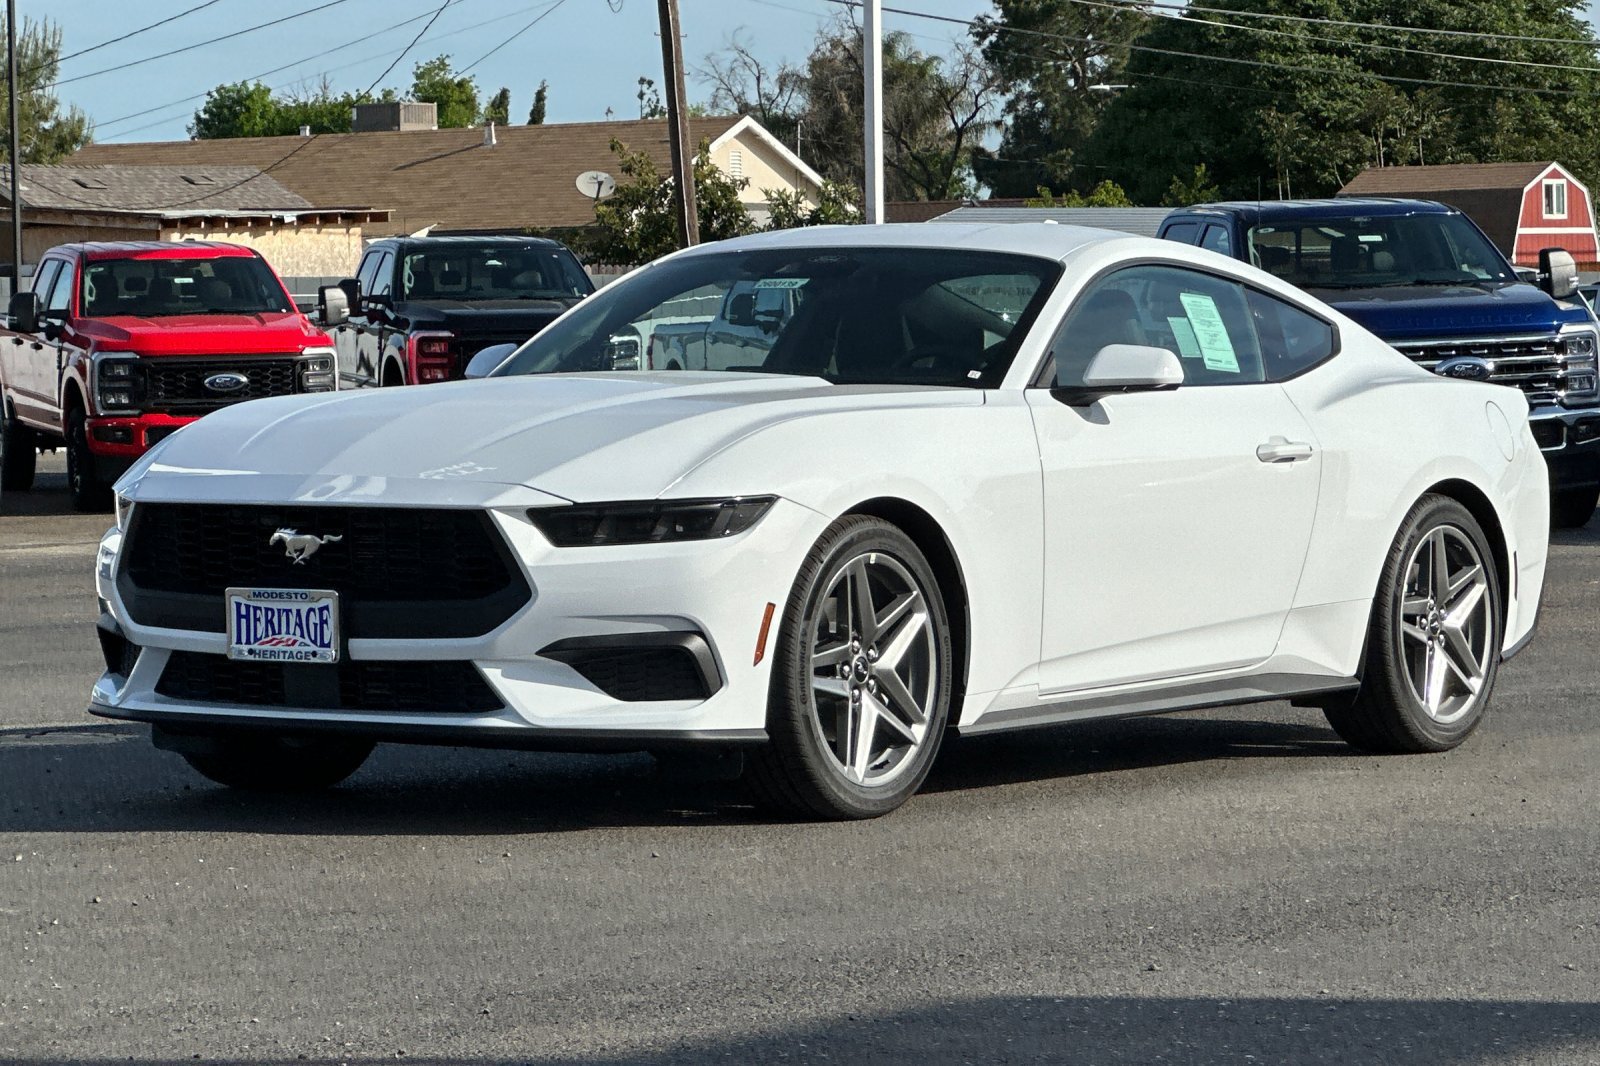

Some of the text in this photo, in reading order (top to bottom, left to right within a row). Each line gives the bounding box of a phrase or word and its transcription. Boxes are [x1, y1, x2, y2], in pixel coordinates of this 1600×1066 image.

[252, 591, 309, 600] MODESTO
[234, 601, 332, 648] HERITAGE
[253, 649, 312, 660] HERITAGE
